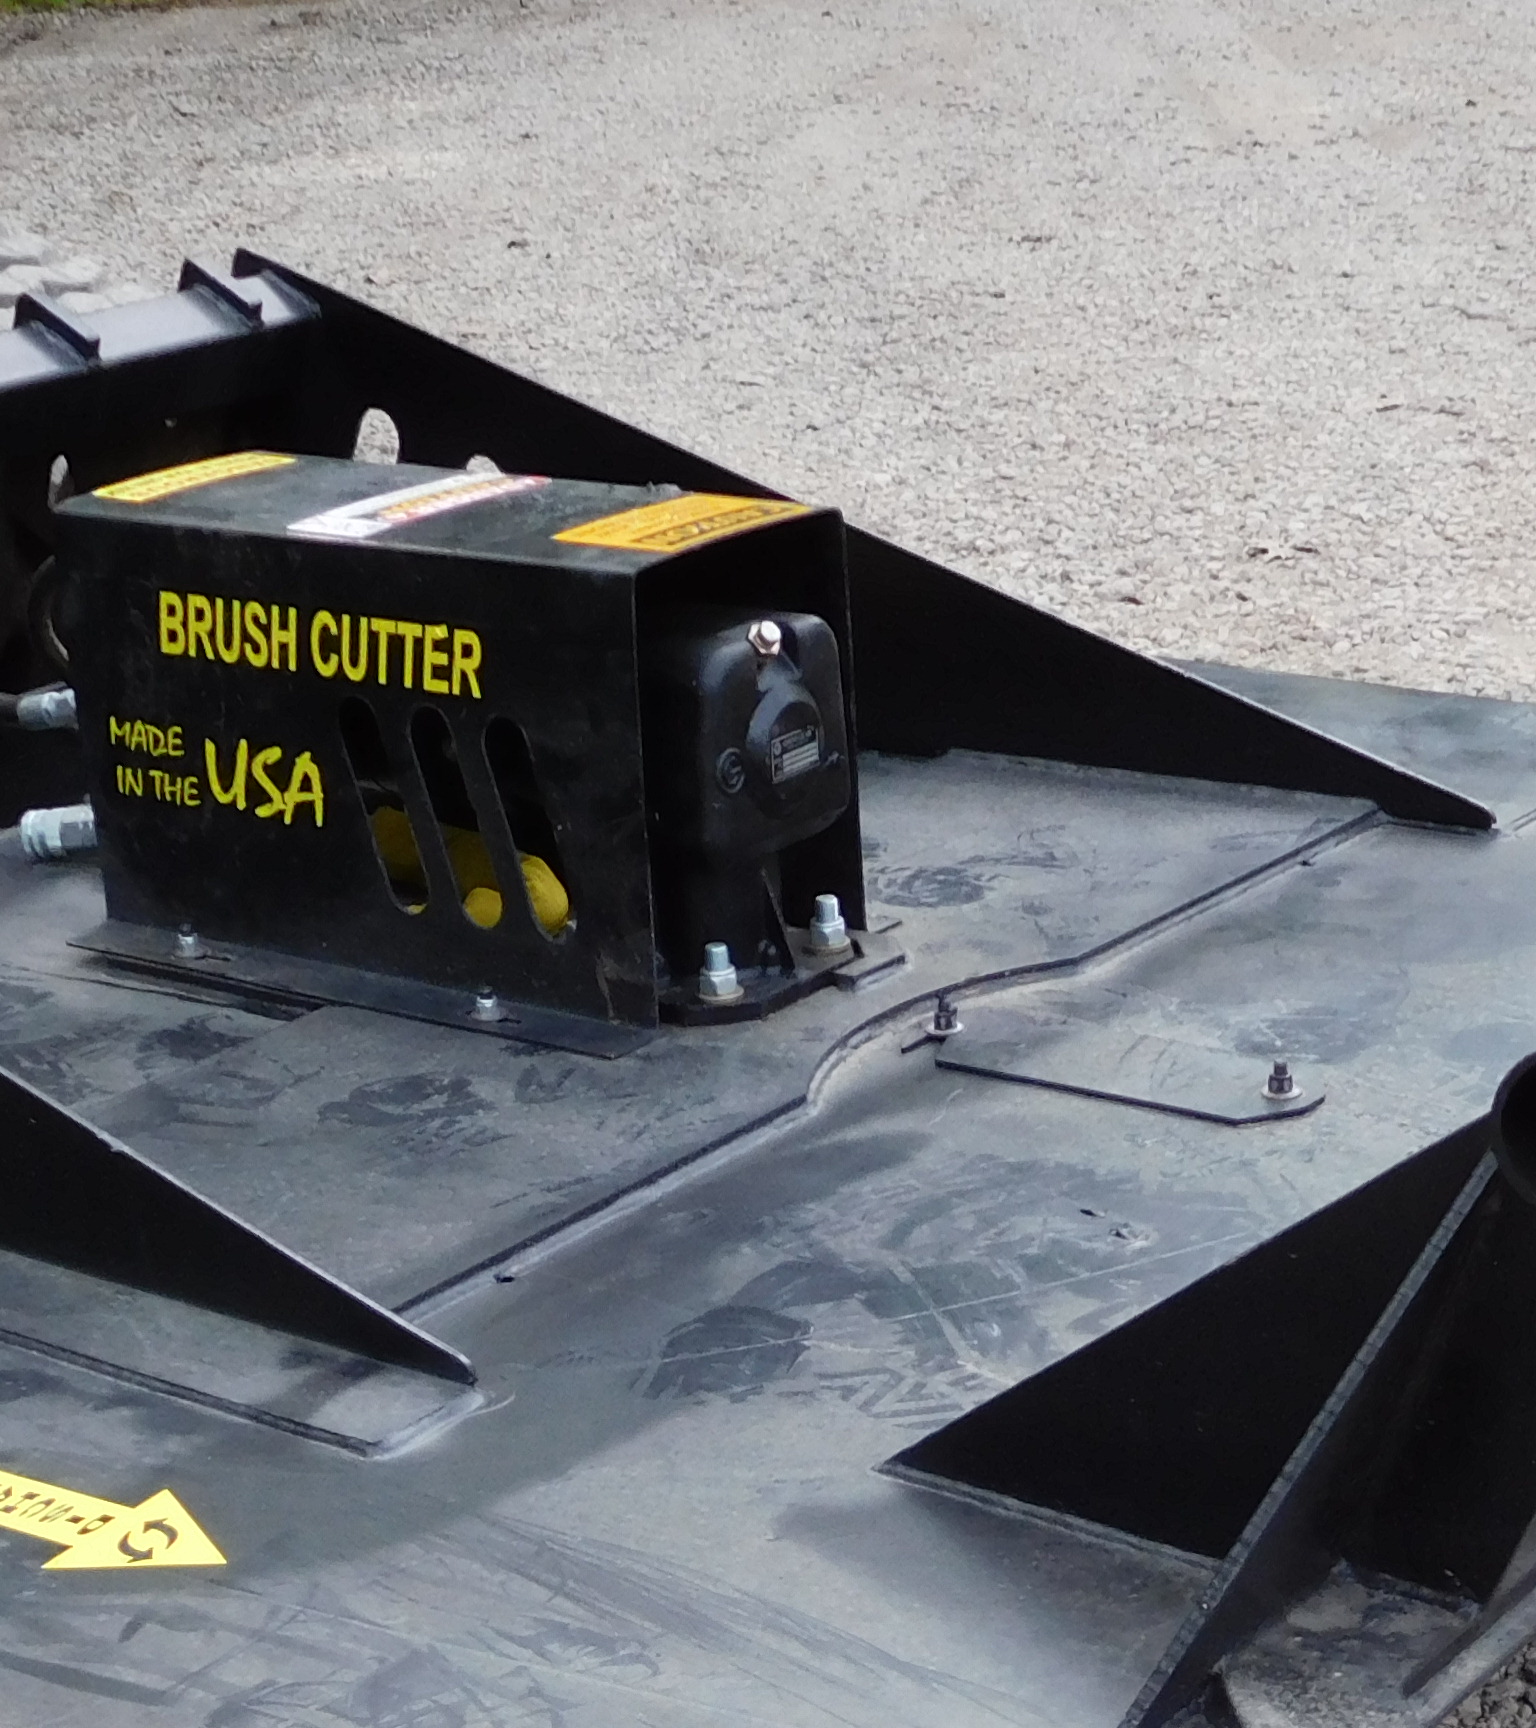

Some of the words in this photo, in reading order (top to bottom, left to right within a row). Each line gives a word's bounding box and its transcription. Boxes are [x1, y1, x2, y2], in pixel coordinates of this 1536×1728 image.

[158, 589, 298, 673] BRUSH
[309, 609, 483, 699] CUTTER
[108, 716, 186, 757] MADE
[116, 766, 143, 797] IN
[149, 769, 202, 807] THE
[203, 738, 325, 826] USA
